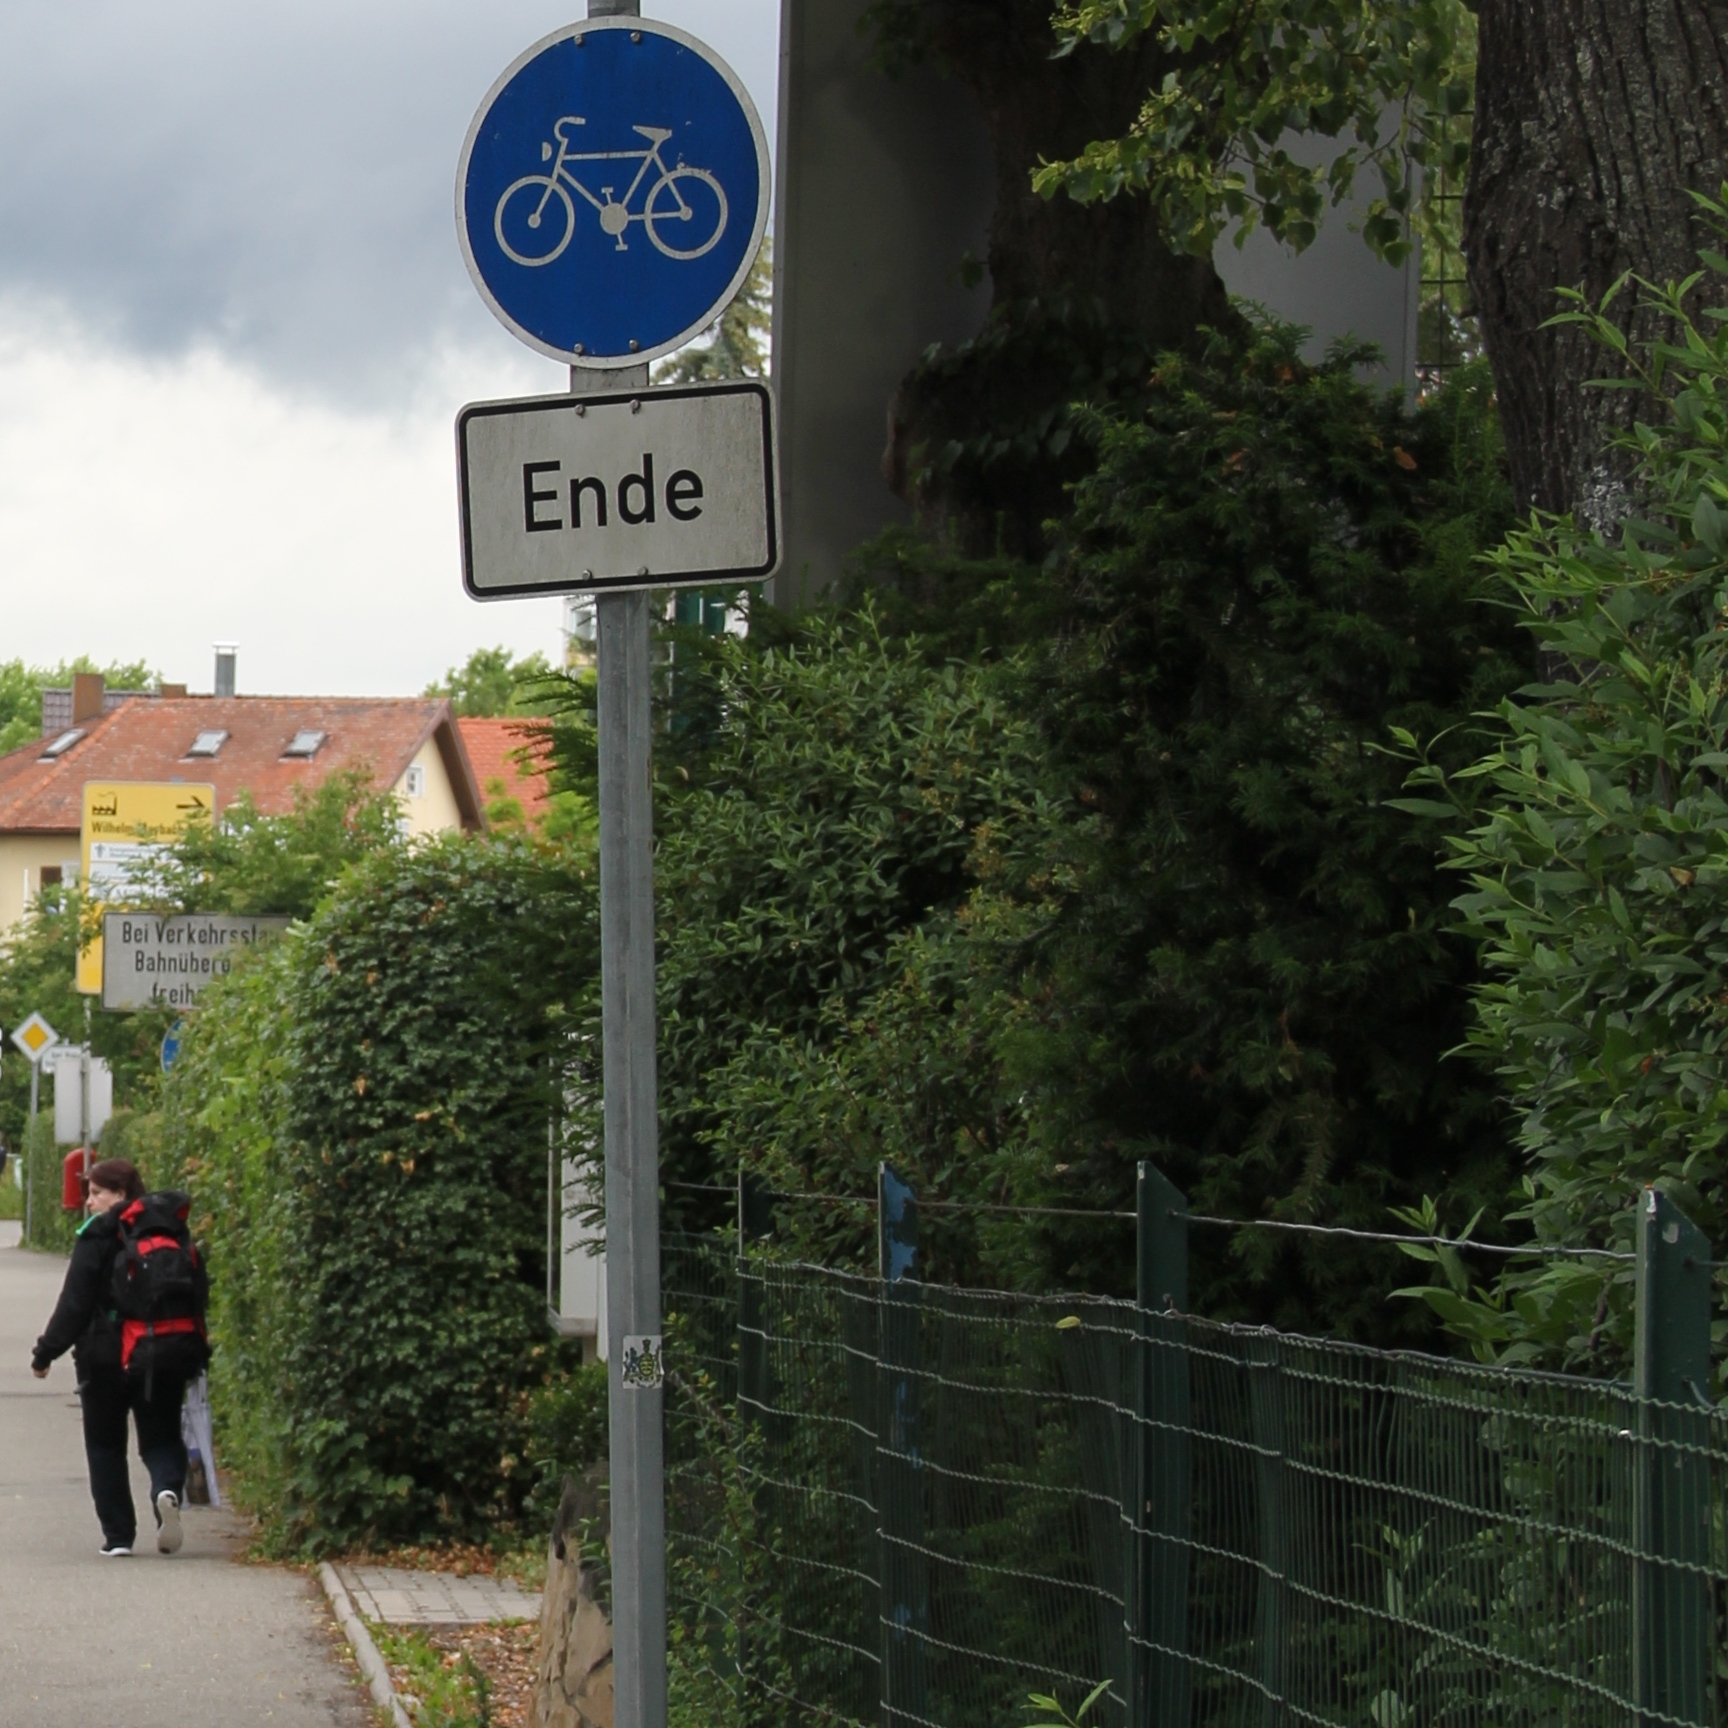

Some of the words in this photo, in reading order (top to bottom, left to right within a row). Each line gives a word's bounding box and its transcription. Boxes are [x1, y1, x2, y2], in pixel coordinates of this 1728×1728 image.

[522, 453, 704, 533] Ende
[122, 921, 149, 944] Bei
[135, 950, 232, 975] Bahnüberg
